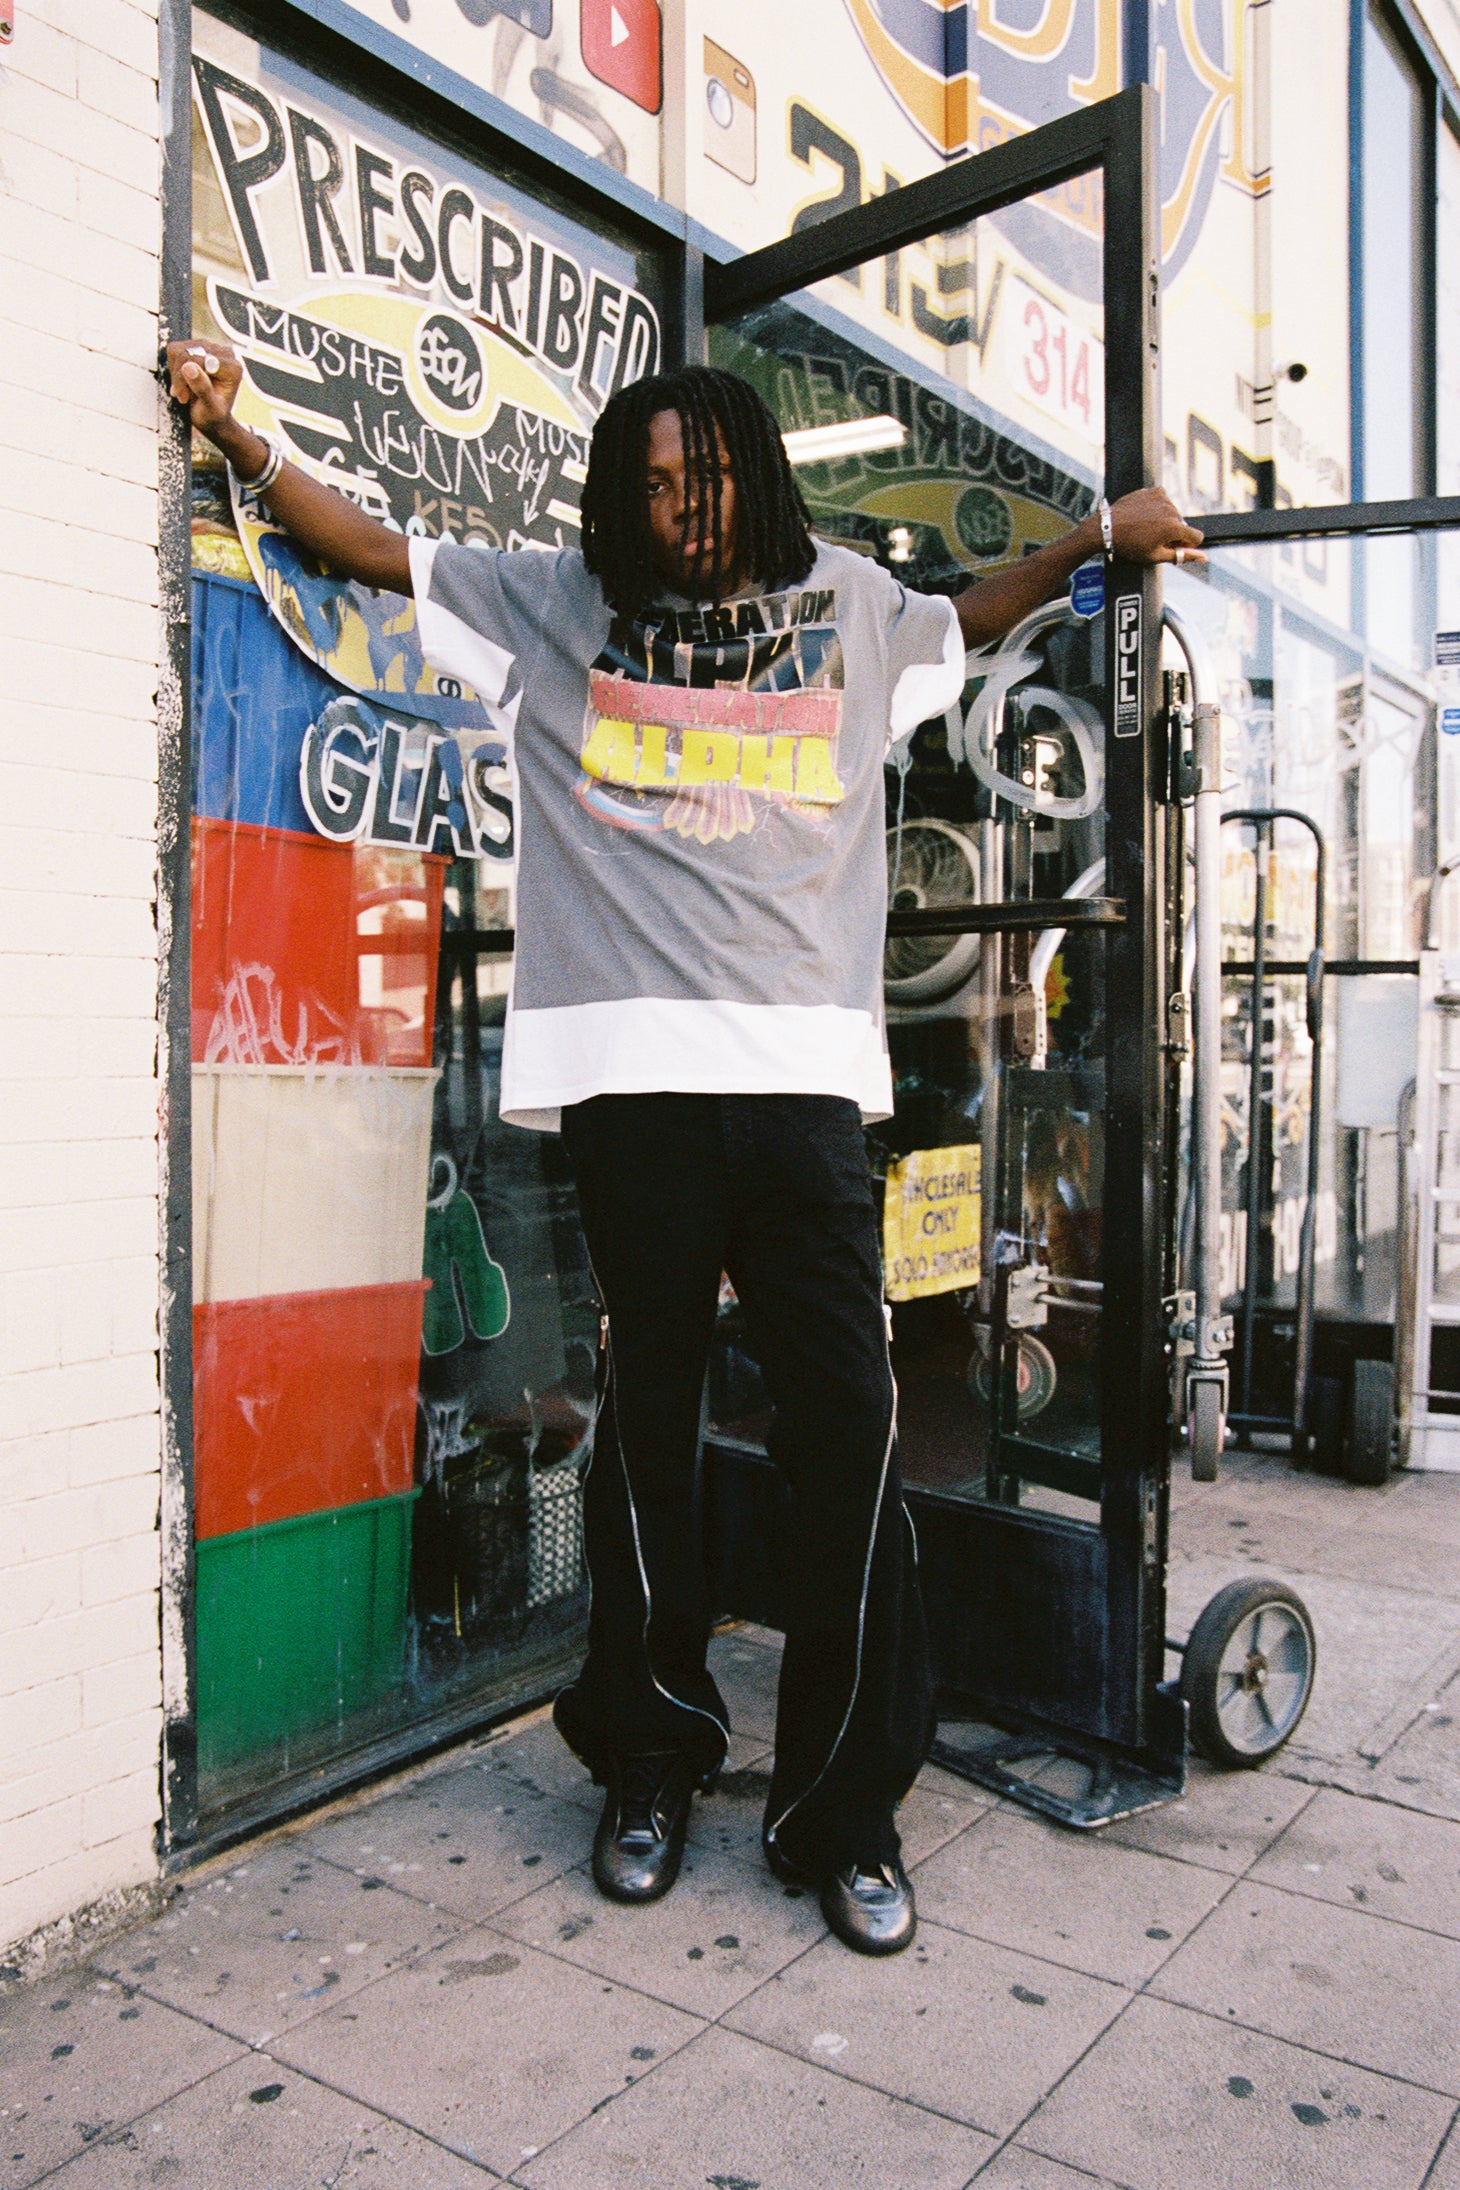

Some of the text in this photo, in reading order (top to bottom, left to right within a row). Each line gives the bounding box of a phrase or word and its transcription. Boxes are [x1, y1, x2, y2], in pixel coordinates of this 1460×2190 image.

[192, 52, 661, 418] PRESCRIBED
[1022, 299, 1092, 426] 314
[1118, 607, 1138, 702] PULL
[580, 718, 845, 802] ALPHA
